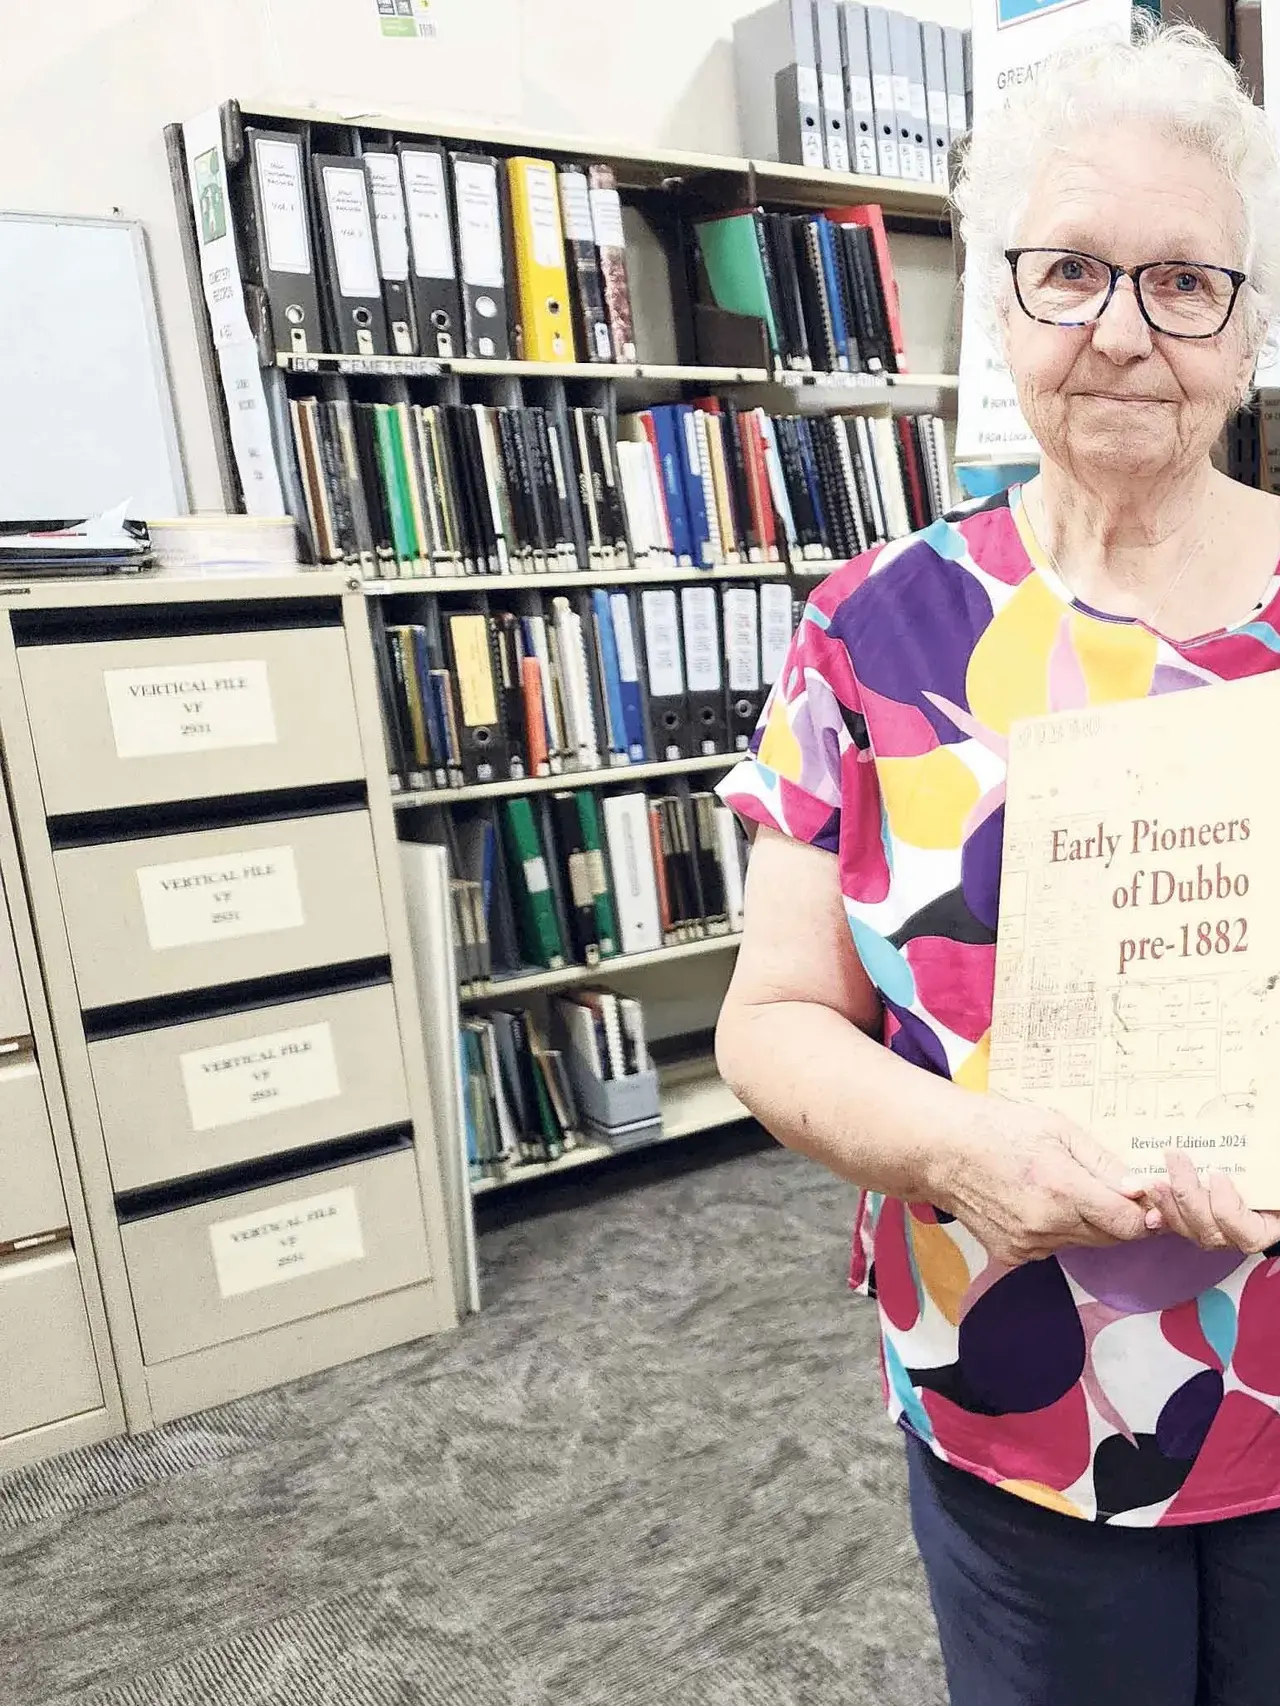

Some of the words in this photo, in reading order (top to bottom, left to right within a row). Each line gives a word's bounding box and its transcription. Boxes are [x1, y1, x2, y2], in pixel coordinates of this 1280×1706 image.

[129, 680, 209, 697] VERTICAL
[214, 677, 248, 691] FILE
[182, 701, 203, 714] VF
[1049, 822, 1122, 869] Early
[1130, 817, 1251, 855] Pioneers
[160, 870, 238, 891] VERTICAL
[243, 864, 274, 879] FILE
[1112, 870, 1145, 909] of
[1150, 862, 1250, 906] Dubbo
[213, 891, 232, 902] VF
[1116, 917, 1249, 975] pre-1882
[202, 1049, 277, 1074] VERTICAL
[280, 1041, 312, 1056] FILE
[1131, 1136, 1172, 1149] Revised
[1176, 1135, 1216, 1149] Edition
[1219, 1134, 1247, 1147] 2024
[231, 1217, 302, 1242] VERTICAL
[307, 1206, 338, 1221] FILE
